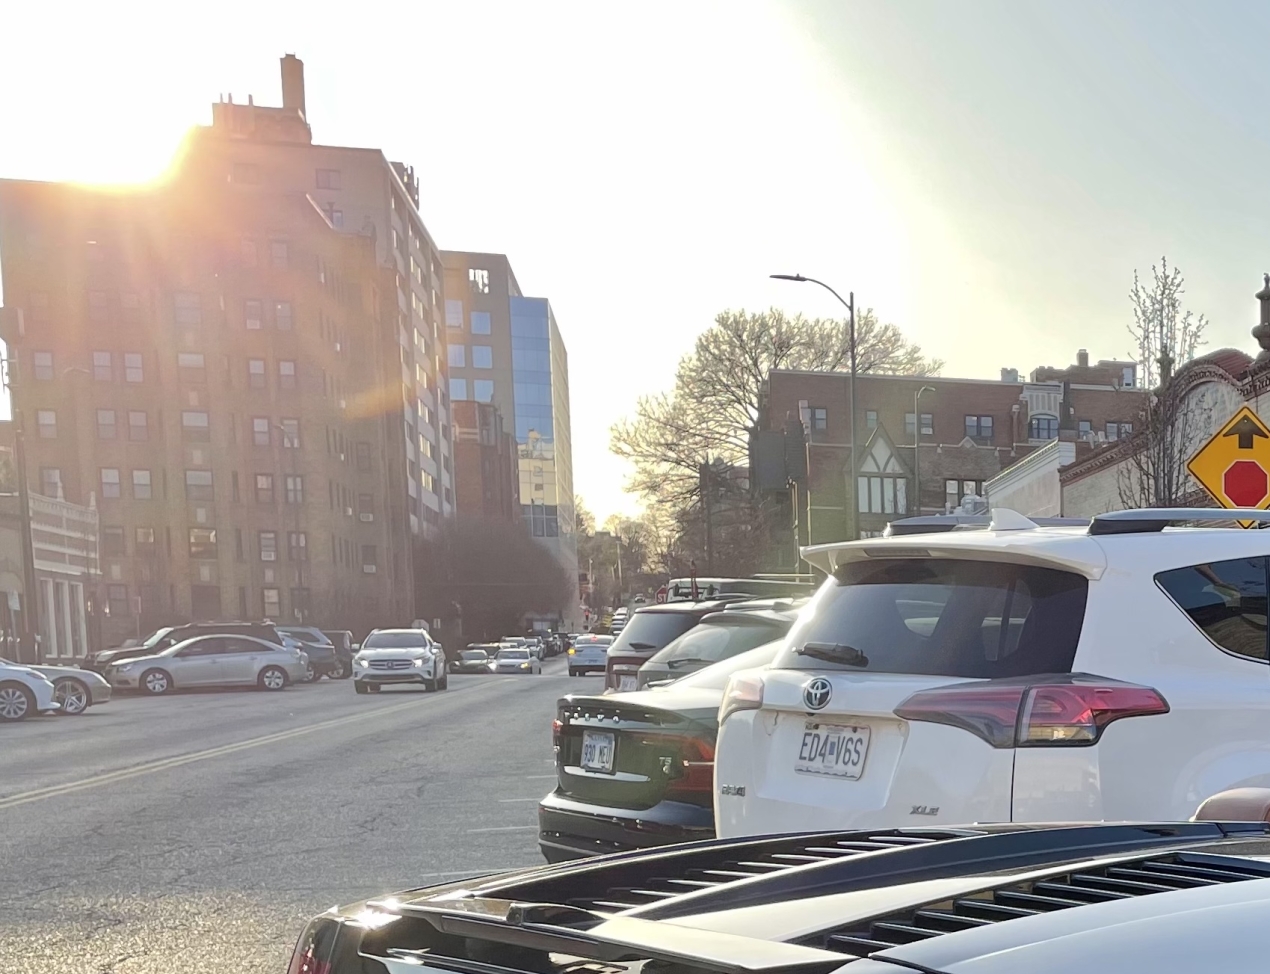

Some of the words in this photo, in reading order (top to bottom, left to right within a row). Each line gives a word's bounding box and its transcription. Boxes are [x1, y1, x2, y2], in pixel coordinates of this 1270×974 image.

[799, 732, 830, 764] ED4
[835, 735, 864, 767] V6S
[908, 804, 940, 816] XLE
